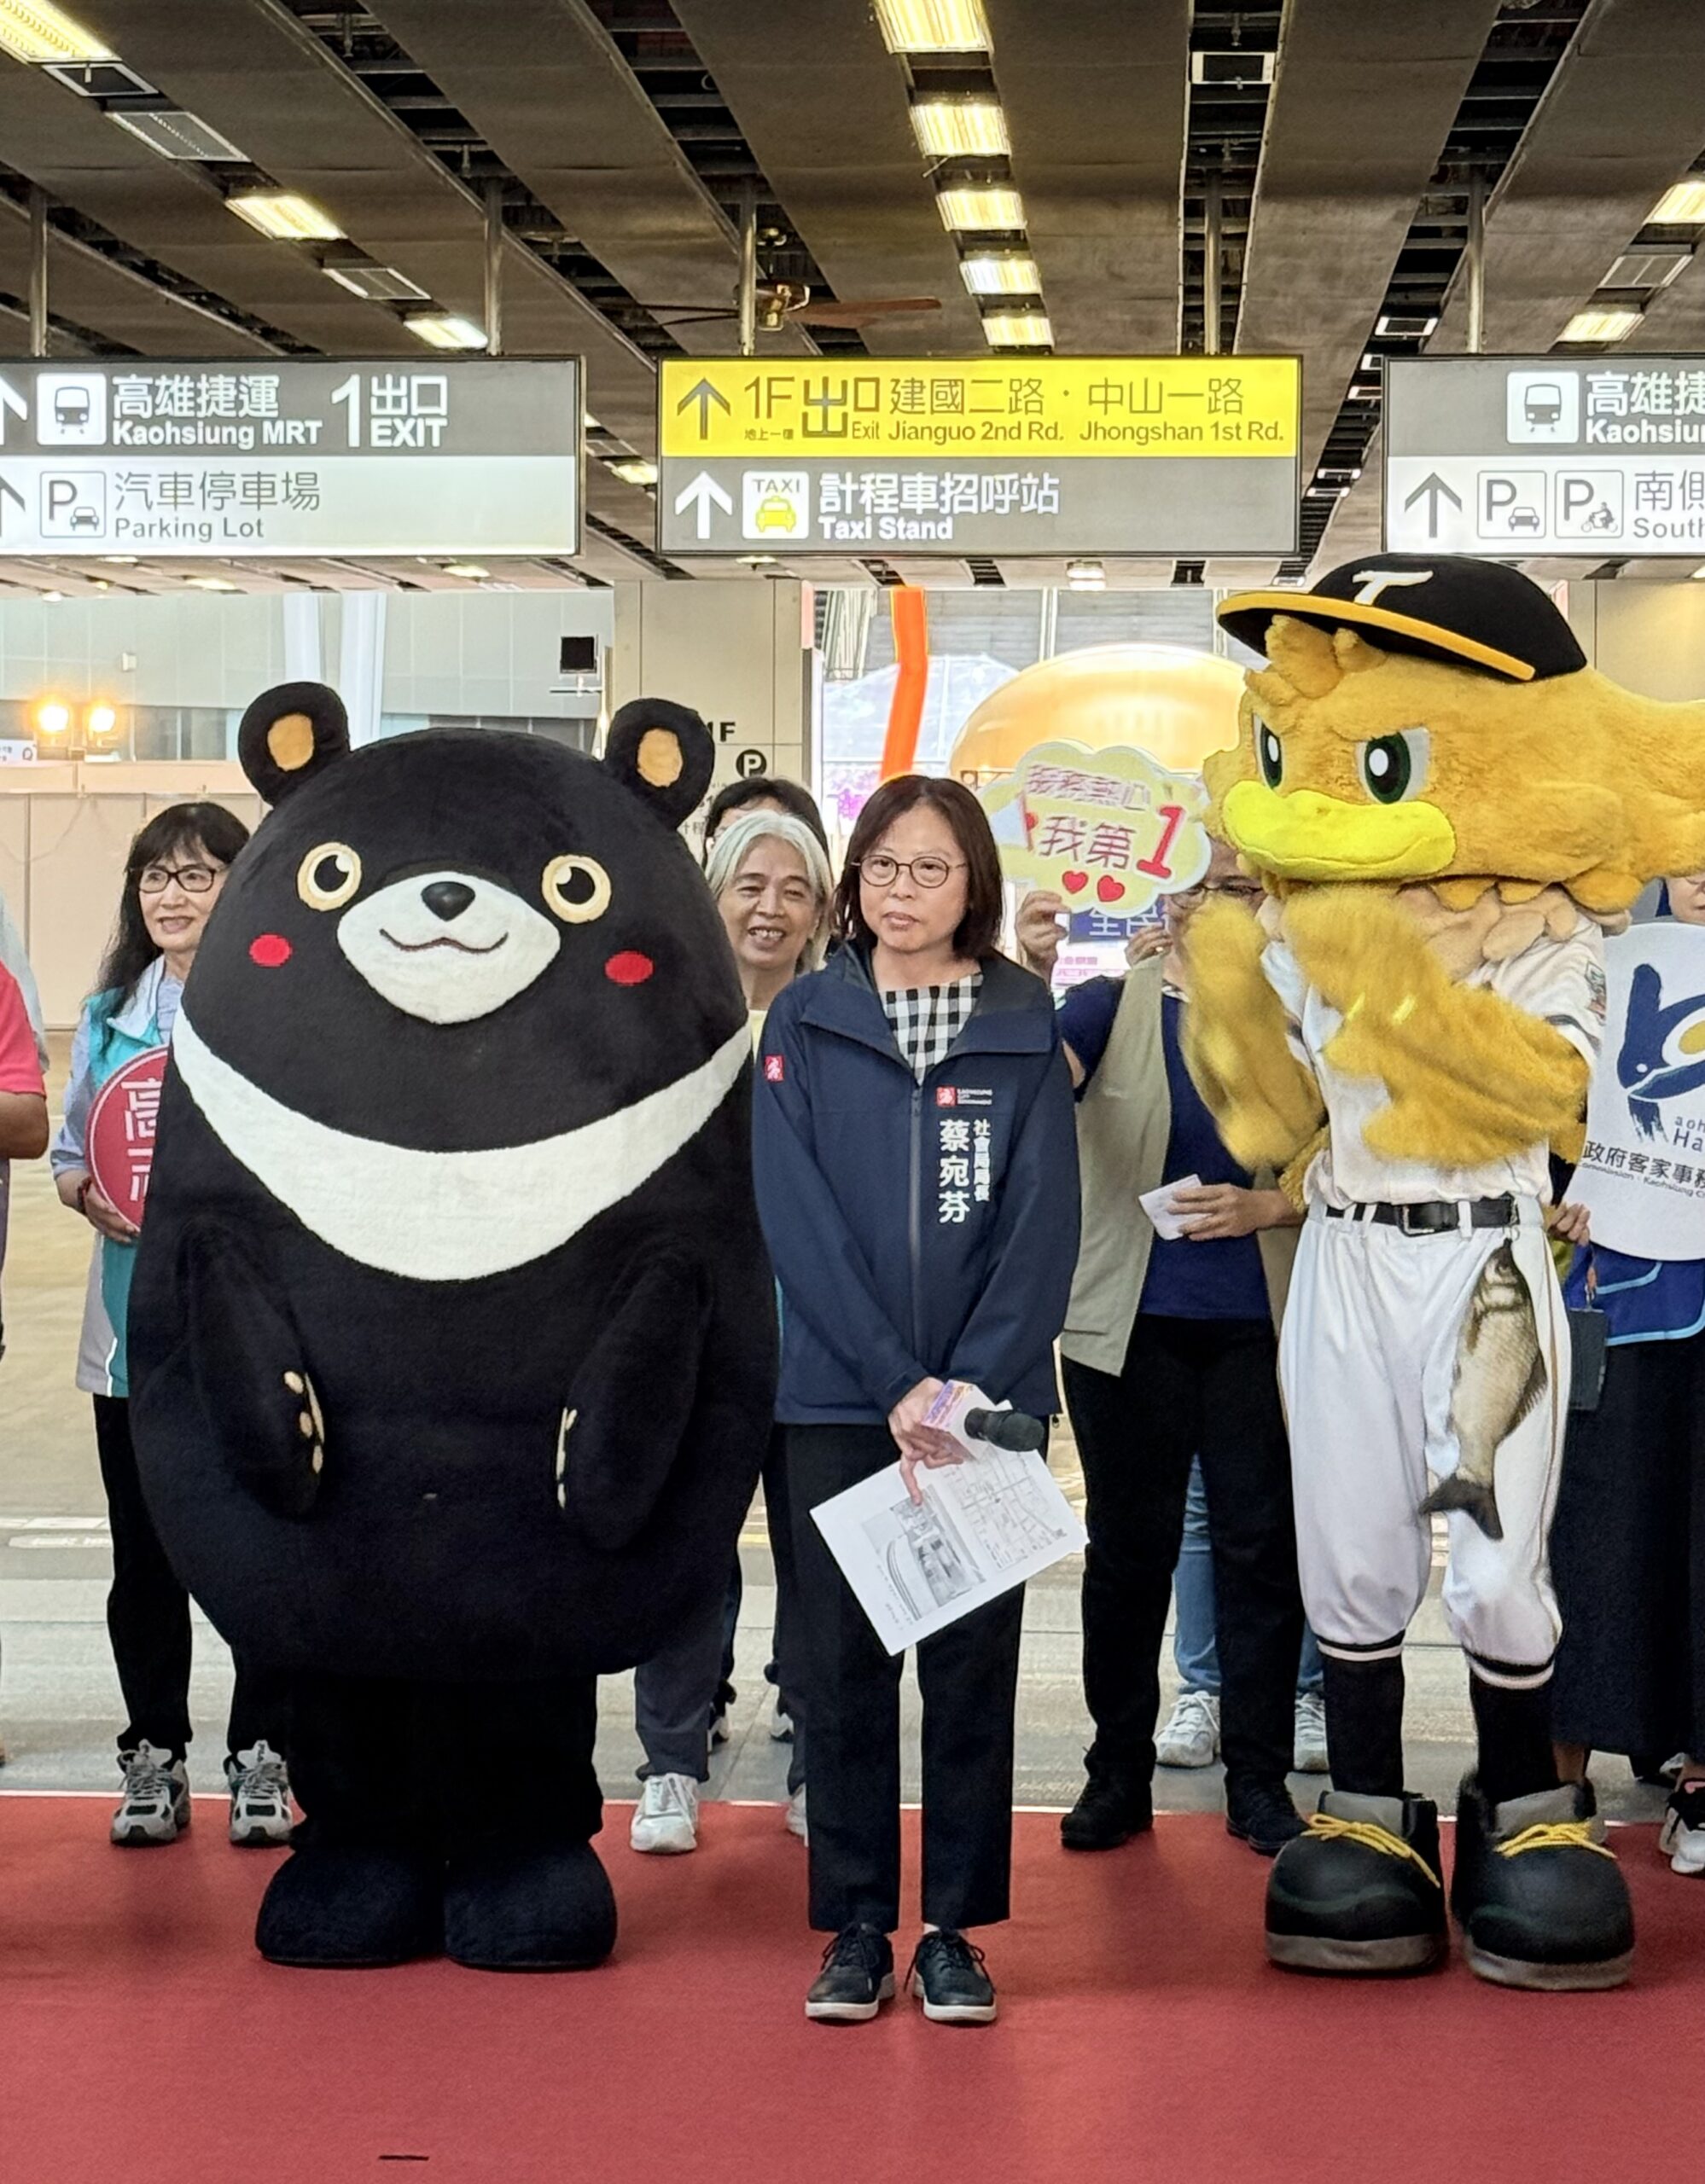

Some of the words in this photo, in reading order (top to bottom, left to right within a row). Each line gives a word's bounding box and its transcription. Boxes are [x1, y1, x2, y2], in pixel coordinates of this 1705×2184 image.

[112, 374, 280, 419] 高雄捷運
[330, 374, 361, 448] 1
[370, 374, 448, 417] 出口
[1586, 370, 1705, 416] 高雄捷
[112, 420, 255, 450] Kaohsiung
[262, 421, 323, 445] MRT
[370, 418, 448, 448] EXIT
[852, 421, 880, 440] Exit
[888, 421, 976, 445] Jianguo
[981, 421, 1021, 442] 2nd
[1027, 421, 1065, 442] Rd.
[1079, 421, 1203, 446] Jhongshan
[1210, 421, 1242, 442] 1st
[1248, 421, 1284, 442] Rd.
[114, 470, 321, 512] 汽車停車場
[753, 478, 800, 494] TAXI
[819, 472, 1060, 514] 計程車招呼站
[114, 517, 212, 543] Parking
[223, 518, 265, 538] Lot
[818, 516, 873, 540] Taxi
[878, 516, 953, 540] Stand
[939, 1118, 971, 1224] 蔡宛芬
